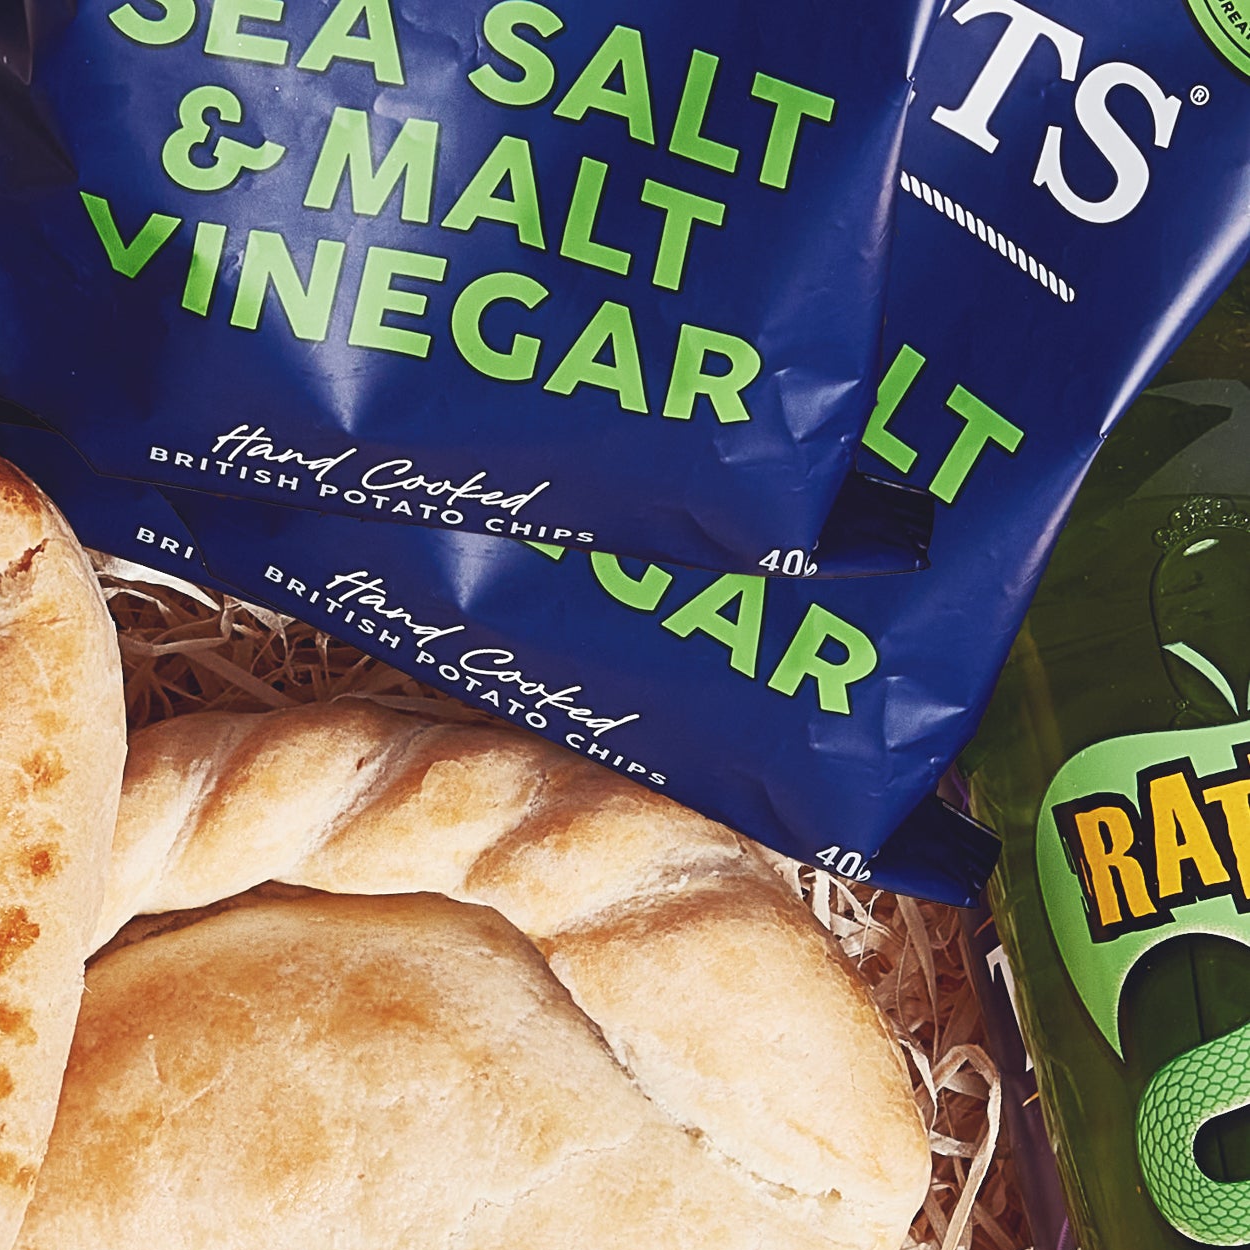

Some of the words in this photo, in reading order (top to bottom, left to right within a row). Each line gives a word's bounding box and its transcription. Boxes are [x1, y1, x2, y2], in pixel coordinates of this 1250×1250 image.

[468, 0, 835, 189] SALT
[1218, 0, 1250, 40] REA
[162, 85, 286, 192] &
[304, 107, 726, 291] MALT
[80, 192, 761, 424] VINEGAR
[150, 446, 299, 491] BRITISH
[319, 483, 464, 525] POTATO
[485, 517, 594, 543] CHIPS
[211, 424, 357, 482] Hand
[361, 459, 550, 515] Cooked
[264, 565, 401, 649] BRITISH
[415, 650, 547, 729] POTATO
[565, 733, 667, 785] CHIPS
[325, 570, 465, 648] Hand
[459, 648, 640, 737] Cooked
[522, 540, 878, 715] GAR
[1074, 754, 1250, 927] RAT
